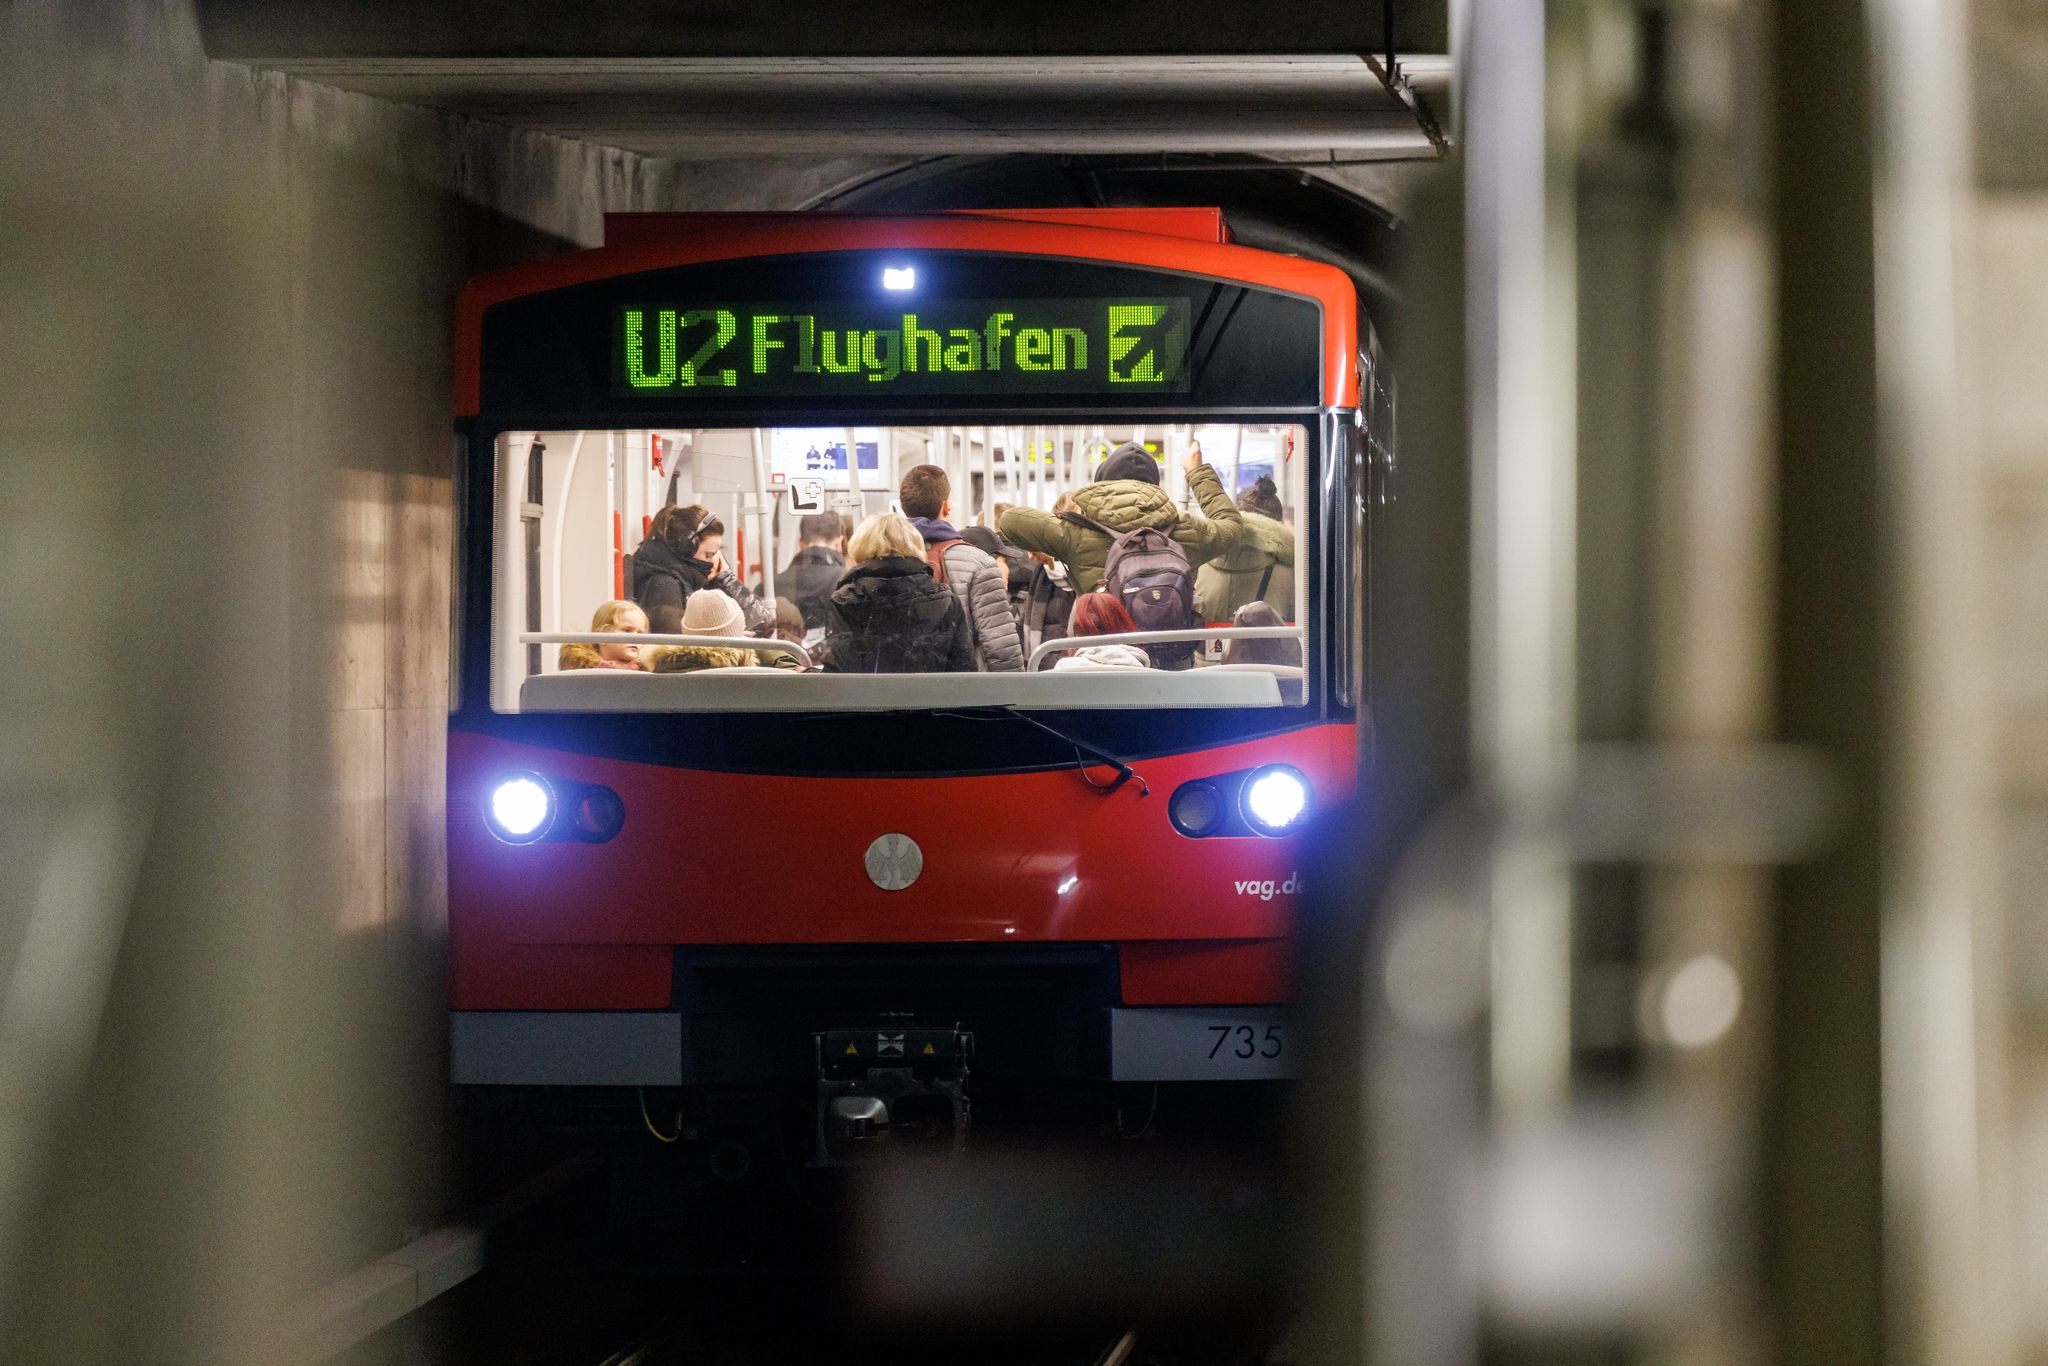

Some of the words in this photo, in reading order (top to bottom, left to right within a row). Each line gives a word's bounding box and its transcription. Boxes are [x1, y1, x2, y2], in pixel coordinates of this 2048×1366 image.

[626, 311, 737, 387] U2
[752, 313, 1088, 382] Flughafen
[1208, 1025, 1283, 1060] 735
